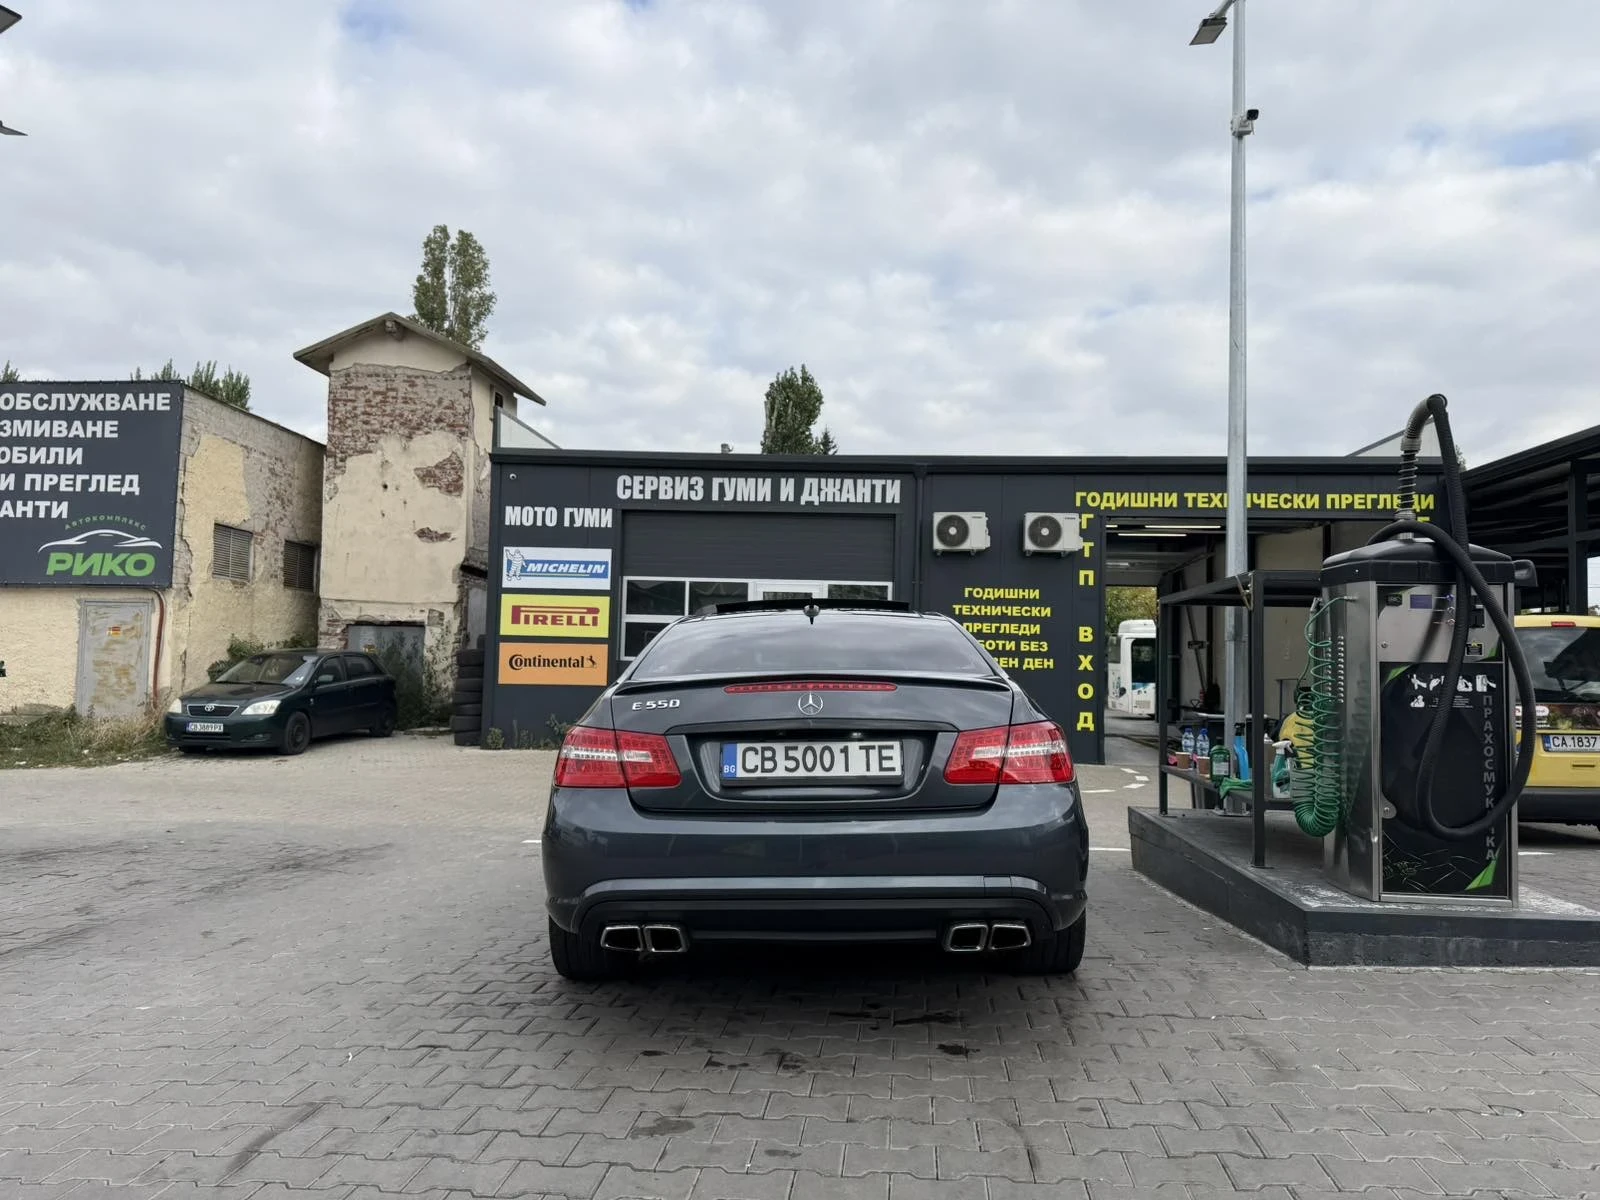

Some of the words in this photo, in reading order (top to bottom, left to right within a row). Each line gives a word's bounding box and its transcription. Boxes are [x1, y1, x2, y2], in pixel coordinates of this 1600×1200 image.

[0, 392, 171, 412] ОБСЛУЖВАНЕ
[0, 419, 119, 439] ЗМИВАНЕ
[0, 473, 15, 491] И
[24, 473, 141, 496] ПРЕГЛЕД
[616, 474, 705, 501] СЕРВИЗ
[711, 476, 772, 502] ГУМИ
[780, 477, 795, 502] И
[800, 477, 901, 506] ДЖАНТИ
[0, 500, 69, 519] АНТИ
[1075, 491, 1178, 510] ГОДИШНИ
[1183, 492, 1320, 510] ТЕХЧЕСКИ
[64, 514, 147, 531] АВТОКОМПЛЕКС
[504, 505, 558, 528] МОТО
[563, 507, 613, 528] ГУМИ
[46, 552, 156, 577] РИКО
[526, 562, 606, 574] MICHELIN
[964, 587, 1040, 600] ГОДИШНИ
[511, 605, 600, 627] PIRELLI
[952, 604, 1052, 618] ТЕХНИЧЕСКИ
[963, 622, 1041, 637] ПРЕГЛЕДИ
[1020, 641, 1049, 652] БЕЗ
[508, 654, 585, 671] Continental
[993, 657, 1019, 669] ЕН
[1022, 657, 1054, 670] ДЕН
[1076, 626, 1095, 732] ВХОД
[631, 702, 643, 711] E
[645, 699, 681, 710] 550
[741, 745, 778, 774] CB
[784, 745, 850, 773] 5001
[858, 744, 897, 773] TE
[723, 764, 736, 774] BG
[1482, 695, 1496, 861] ПРАХОСМУККА
